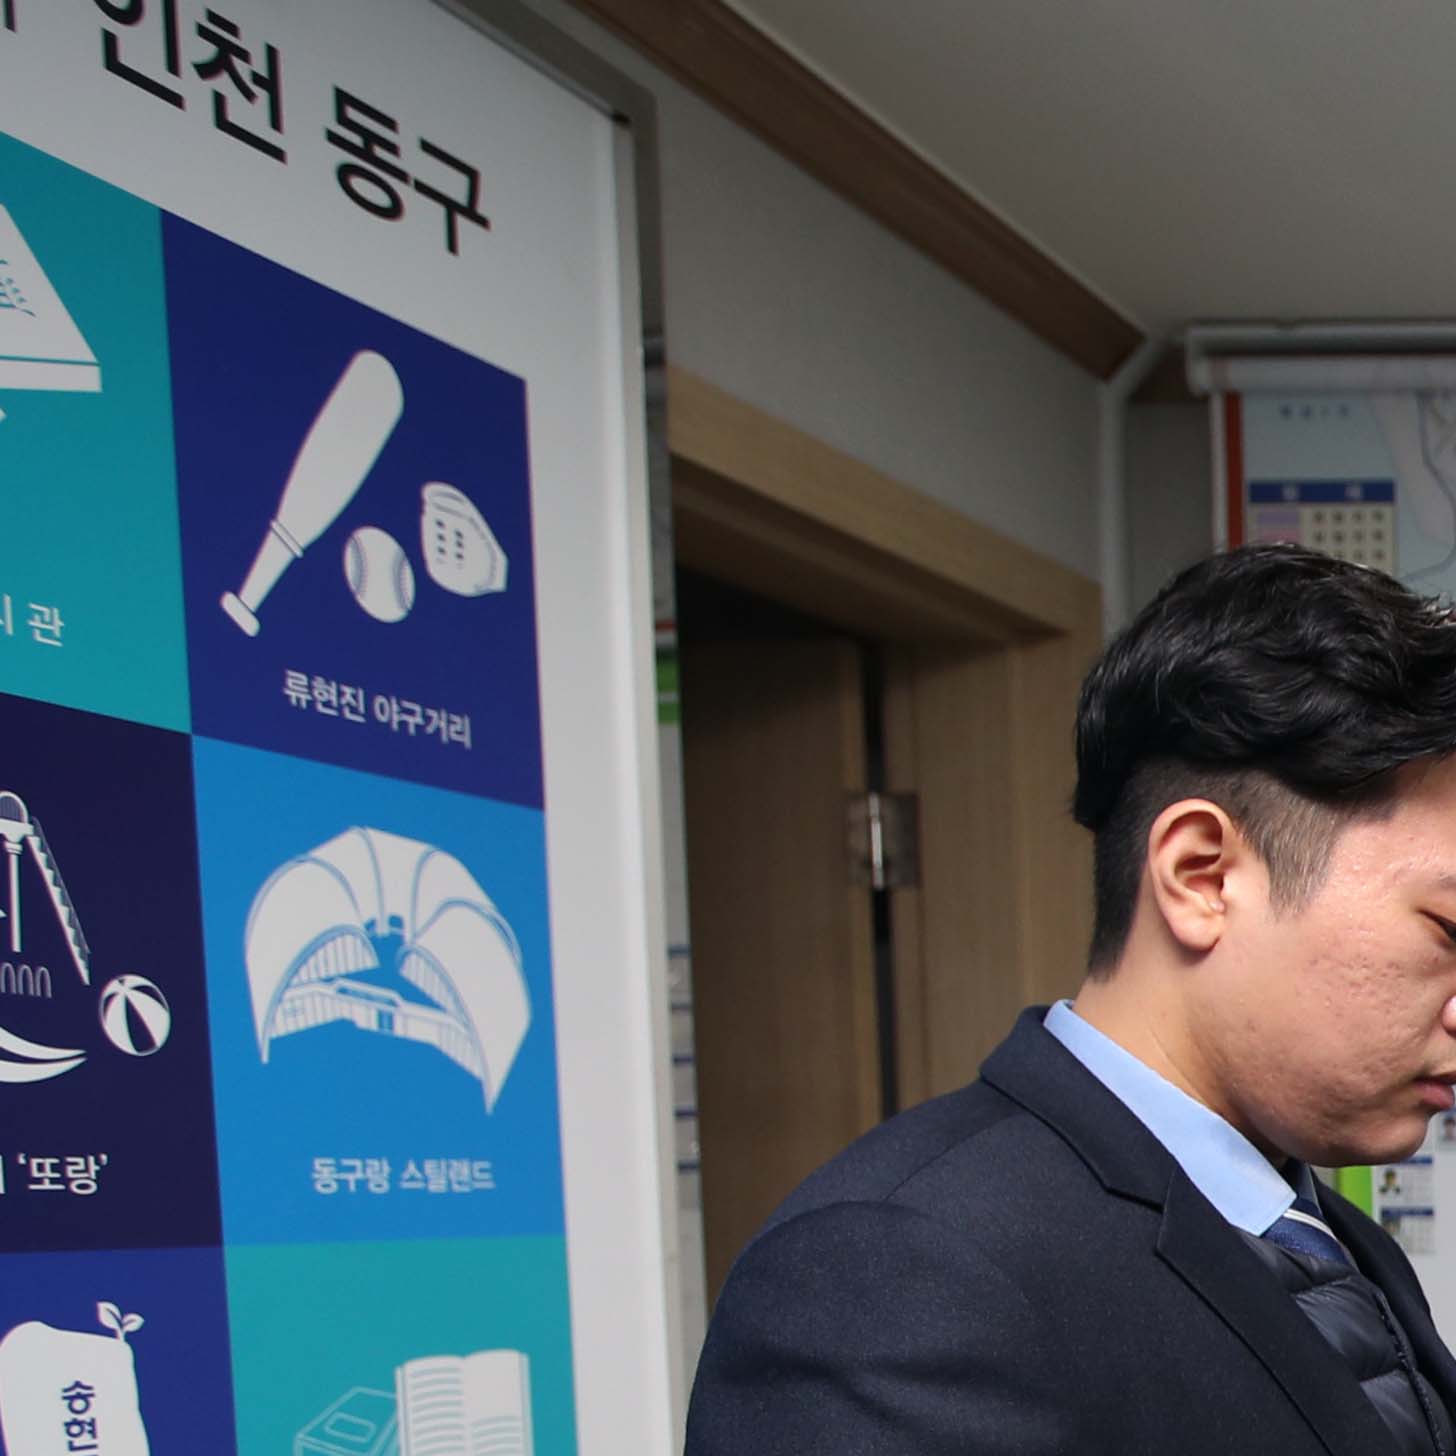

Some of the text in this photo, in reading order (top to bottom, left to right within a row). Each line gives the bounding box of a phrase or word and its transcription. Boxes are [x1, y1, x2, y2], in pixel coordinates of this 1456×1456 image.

[94, 0, 491, 257] 인천 동구
[283, 669, 472, 750] 류현진 야구거리
[311, 1157, 496, 1192] 동구랑 스틸랜드
